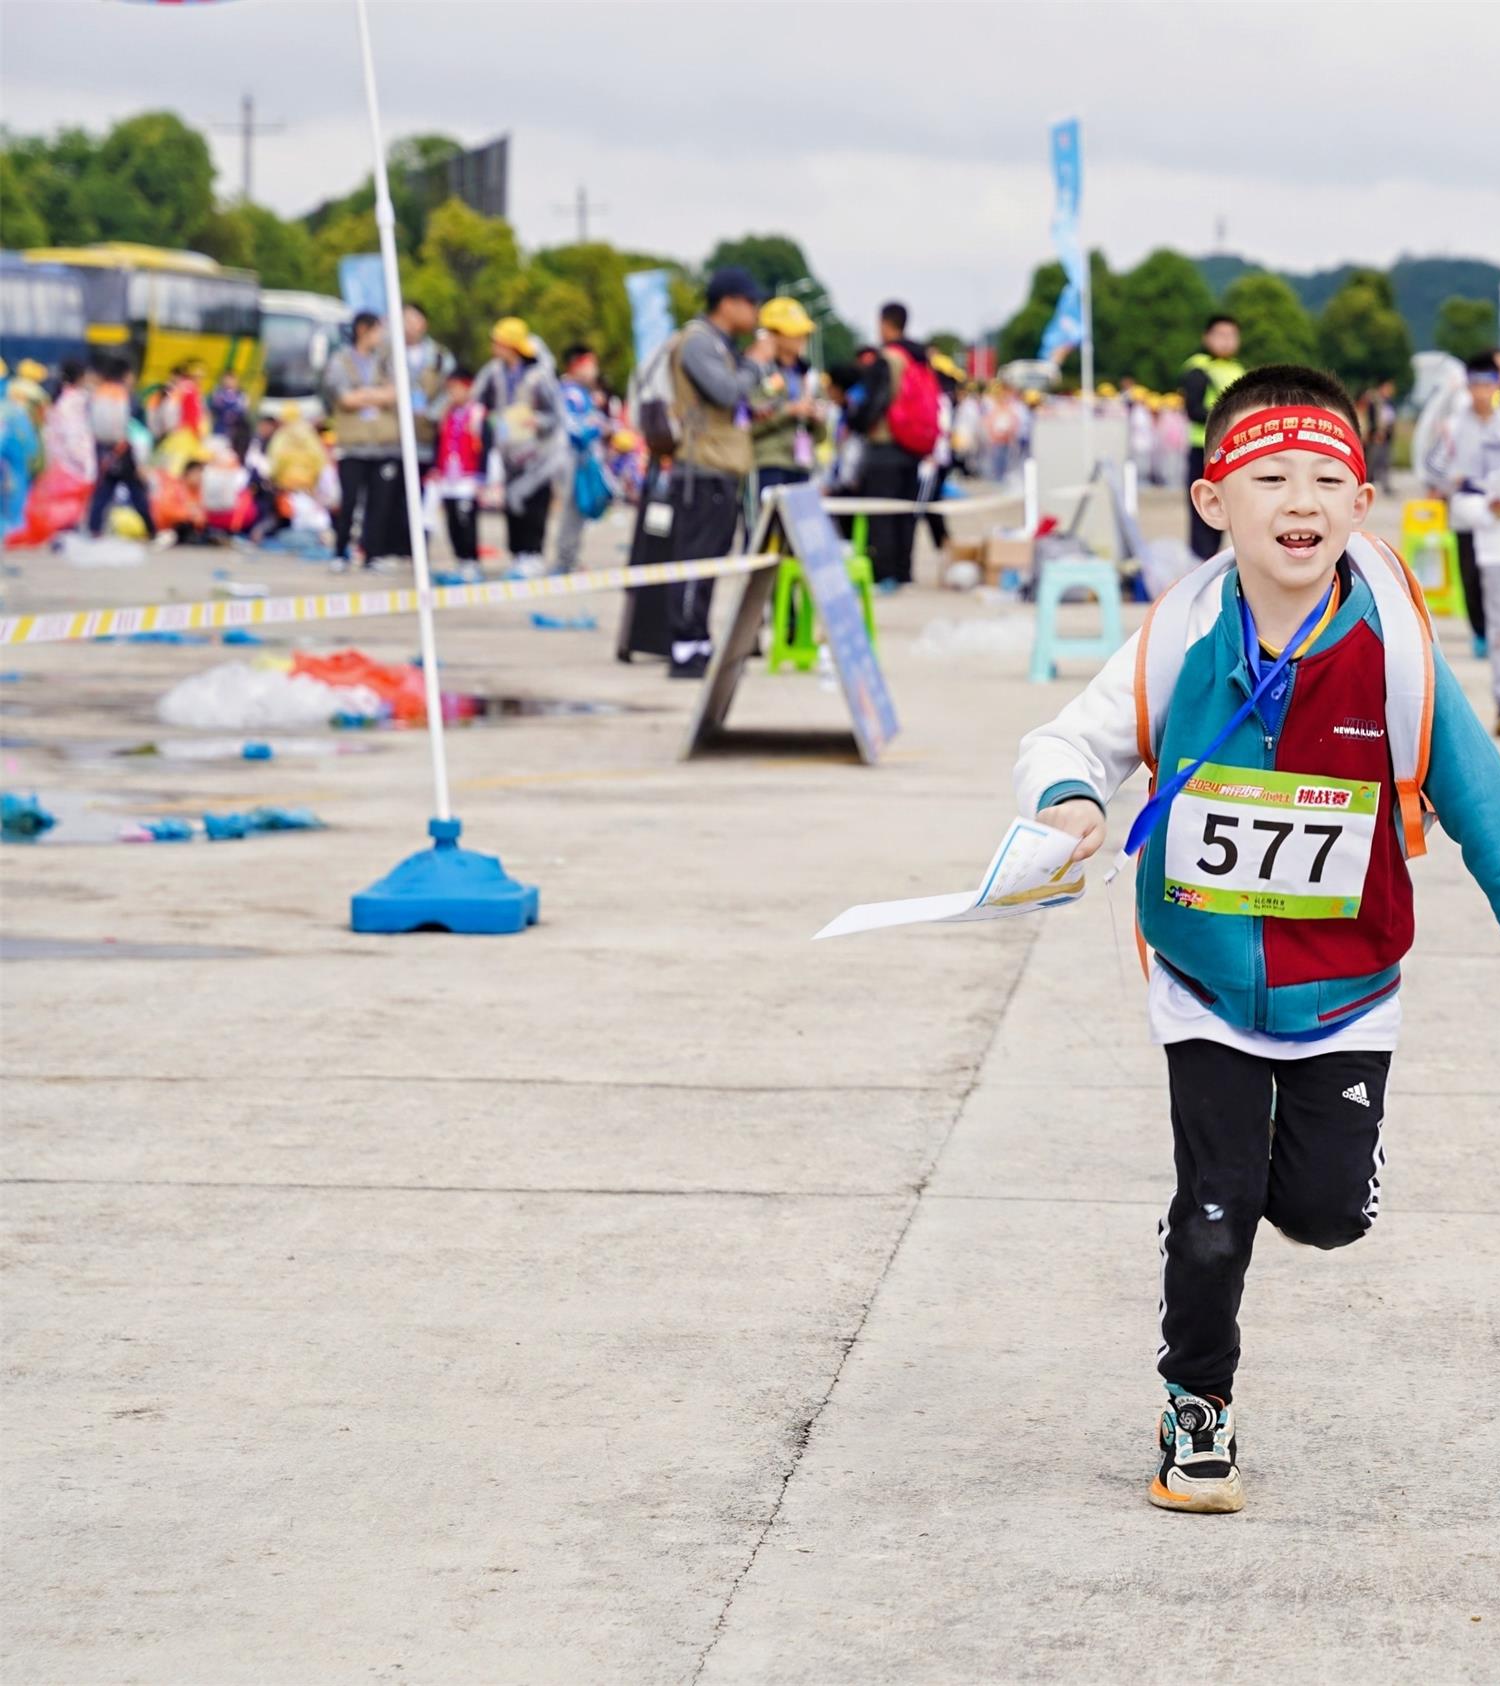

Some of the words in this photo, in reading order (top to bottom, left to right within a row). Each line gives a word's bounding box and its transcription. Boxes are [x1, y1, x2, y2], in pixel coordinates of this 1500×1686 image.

[1297, 788, 1351, 806] 挑战赛
[1196, 813, 1343, 883] 577
[1342, 1090, 1370, 1108] adidas
